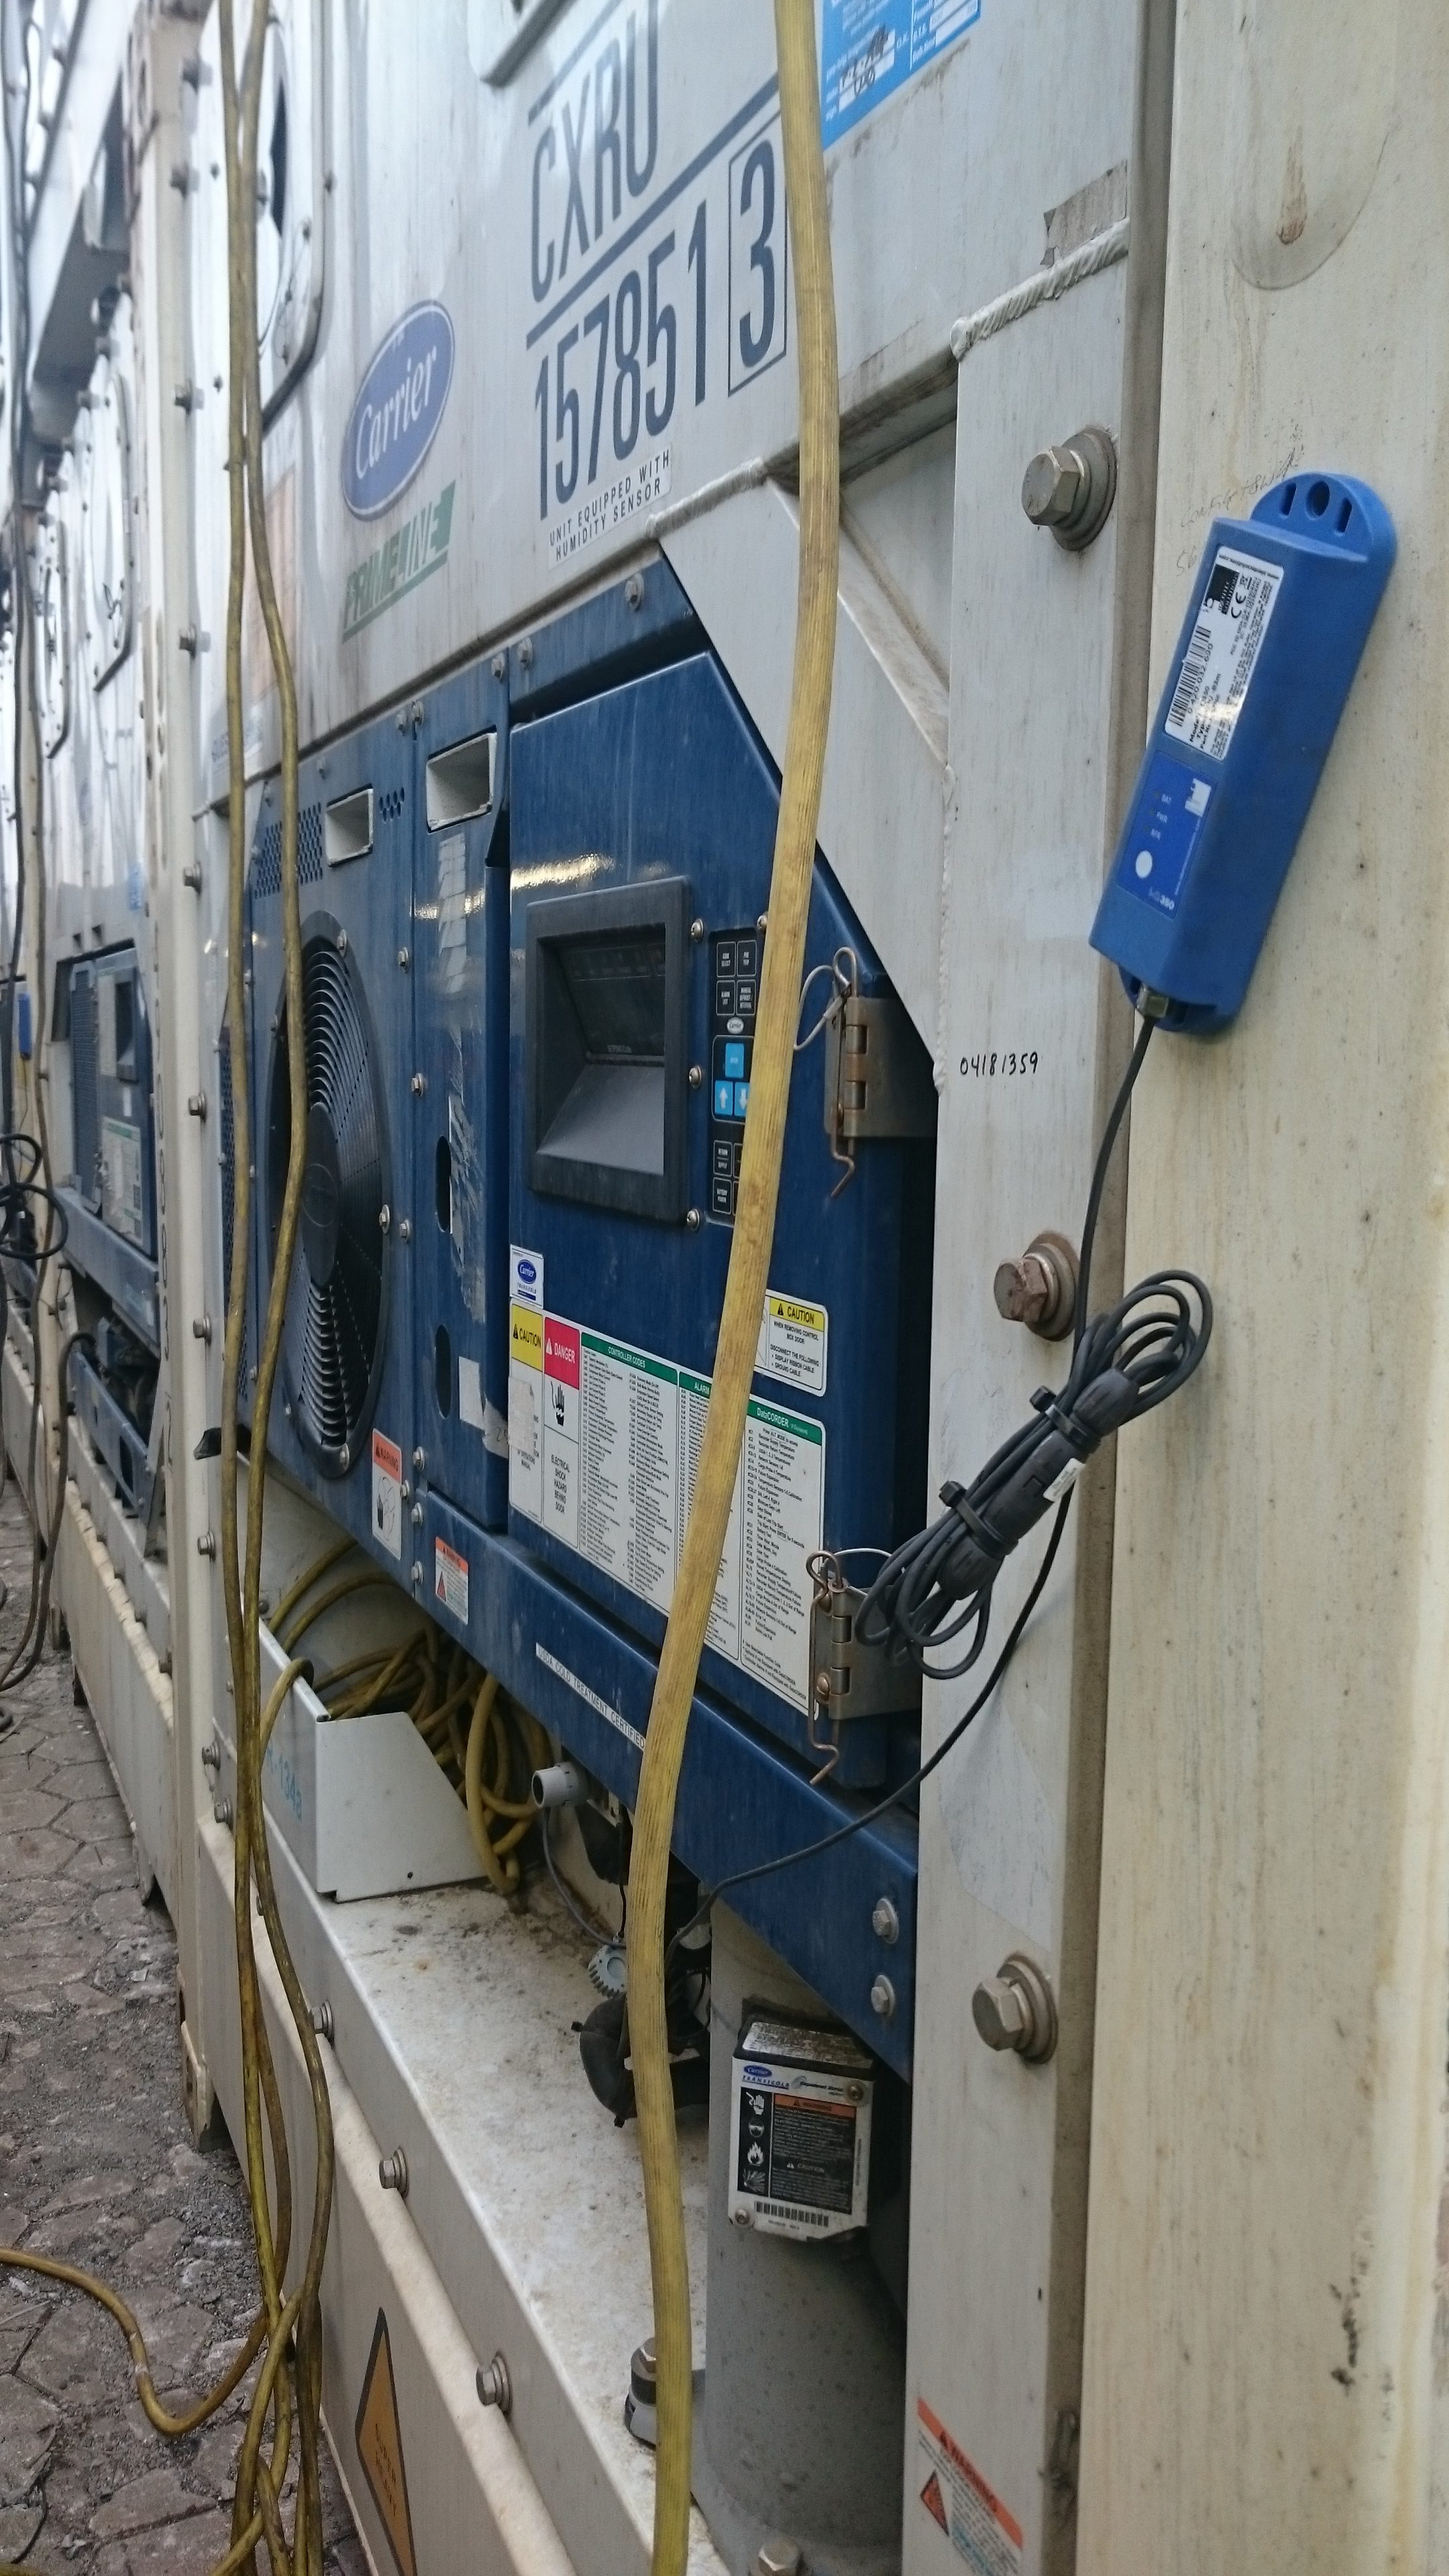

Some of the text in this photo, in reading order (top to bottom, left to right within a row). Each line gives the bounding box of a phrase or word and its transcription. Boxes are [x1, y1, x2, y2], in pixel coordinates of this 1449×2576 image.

[532, 0, 658, 303] CXRU
[535, 140, 775, 521] 157851 3
[355, 345, 437, 480] Carrier
[550, 449, 669, 546] UNIT EQUIPPED WITH
[556, 478, 660, 561] HUMIDITY SENSOR
[960, 1051, 1038, 1077] 04181359
[787, 1305, 814, 1324] CAUTION
[519, 1327, 541, 1349] CAUTION
[784, 1324, 801, 1335] REMOVING
[802, 1330, 818, 1340] CONTROL
[554, 1342, 575, 1364] DANGER
[608, 1346, 645, 1369] CONTROLLER CODES
[789, 1367, 800, 1377] CABLE
[803, 1364, 814, 1373] CABLE
[694, 1381, 709, 1394] ALARM
[757, 1407, 788, 1428] DataCORDER
[551, 1454, 570, 1473] ELECTRICAL
[555, 1467, 566, 1483] SHOCK
[554, 1478, 567, 1494] HAZARD
[554, 1489, 566, 1505] BEHIND
[555, 1501, 564, 1515] DOOR
[555, 1662, 571, 1682] COLD
[574, 1678, 608, 1716] TREATMENT
[610, 1711, 645, 1748] CERTIFIED
